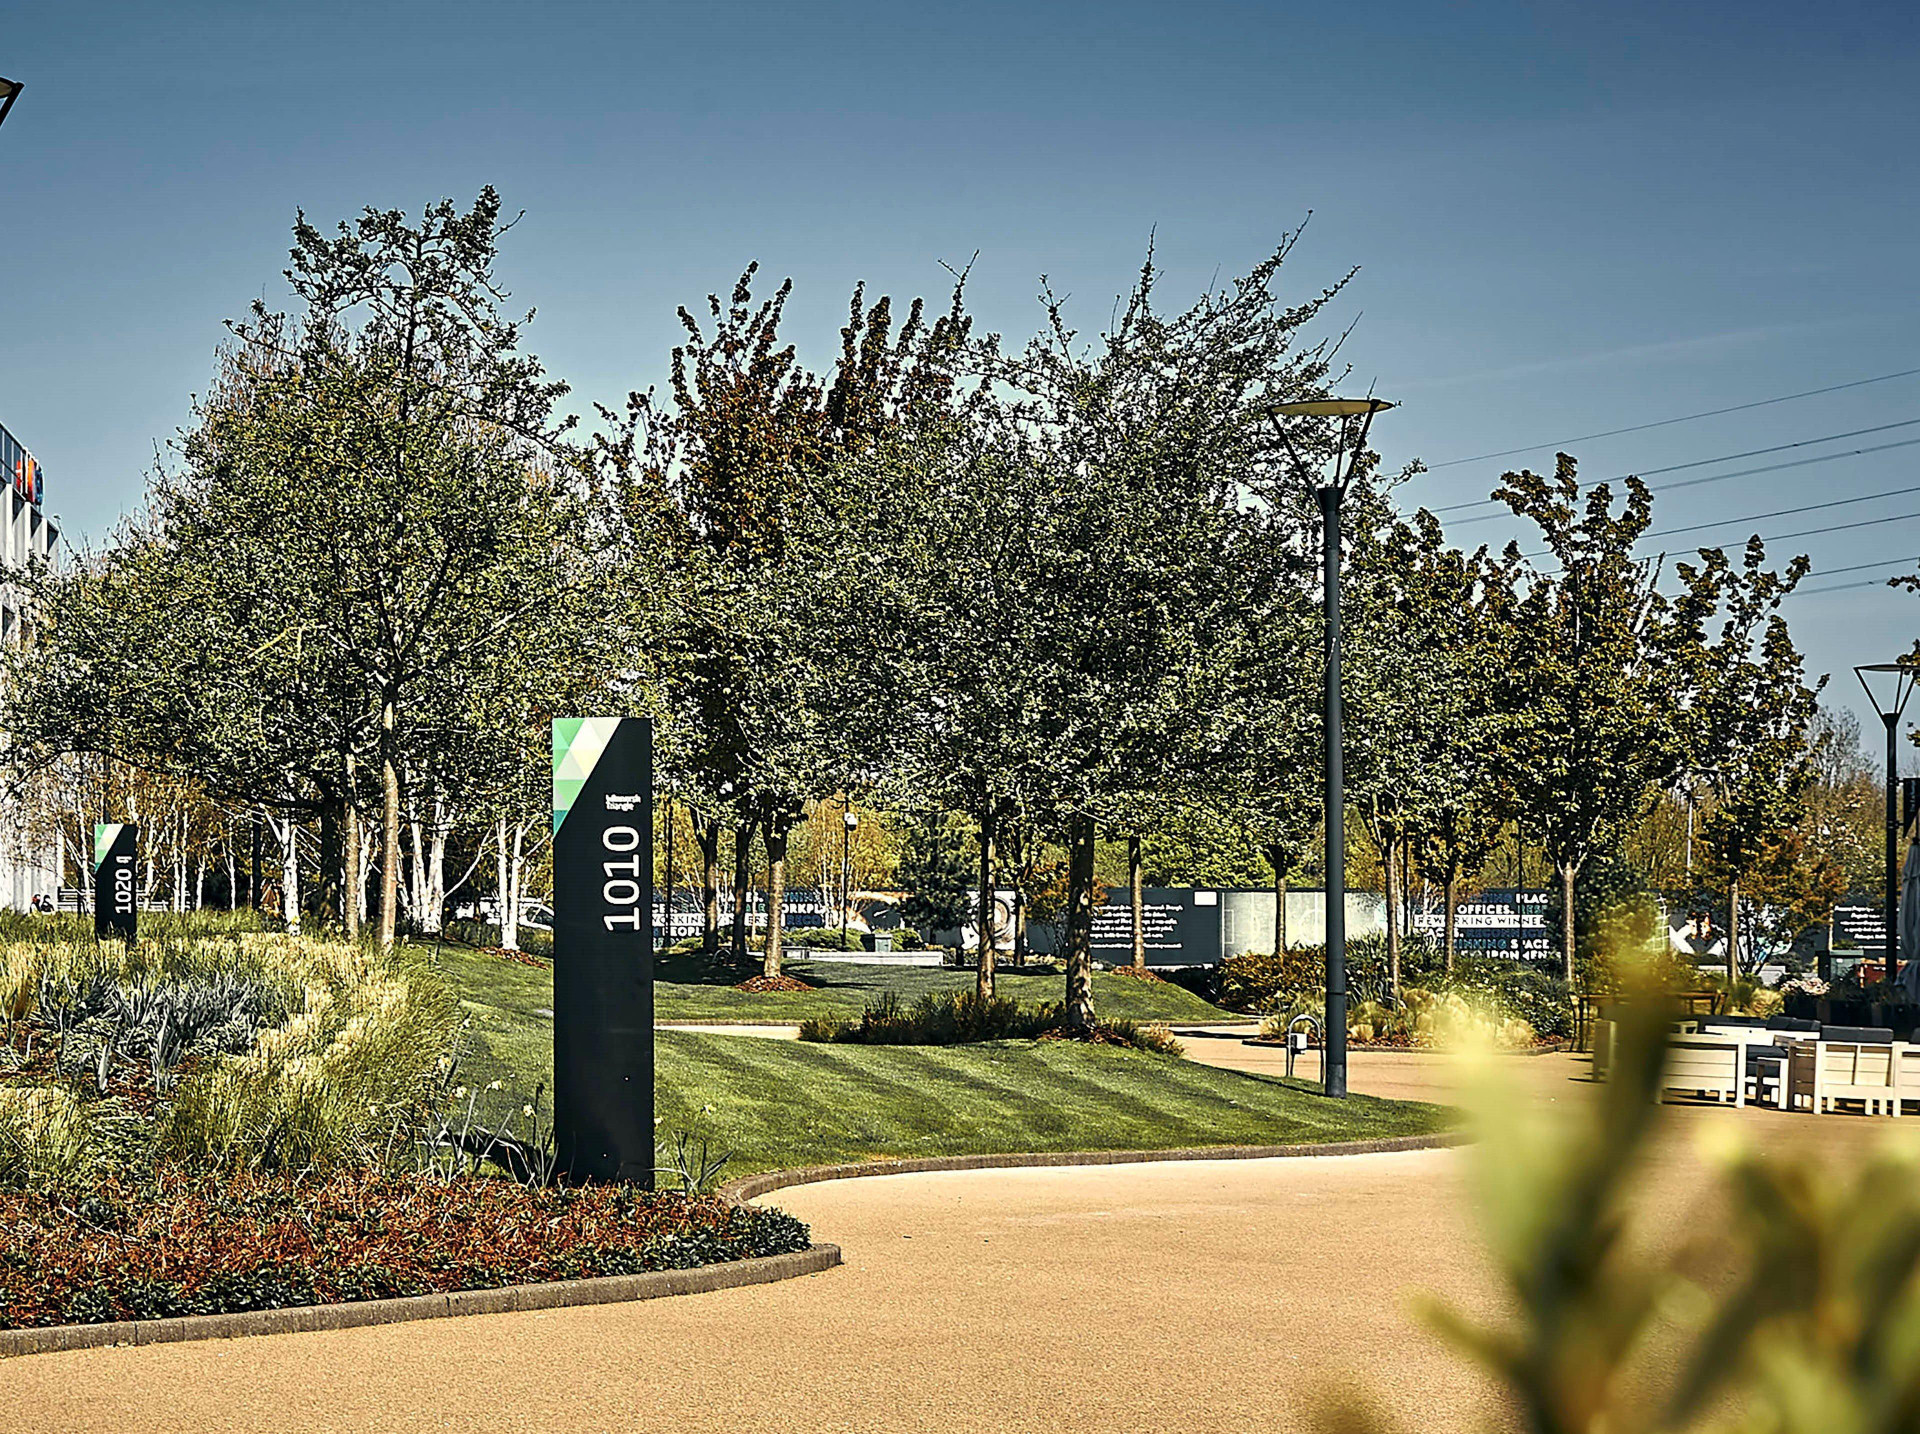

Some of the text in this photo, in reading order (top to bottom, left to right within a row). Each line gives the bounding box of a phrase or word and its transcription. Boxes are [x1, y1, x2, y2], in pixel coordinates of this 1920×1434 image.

[115, 869, 132, 913] 1020
[603, 826, 640, 931] 1010
[1457, 905, 1514, 915] OFFICES.
